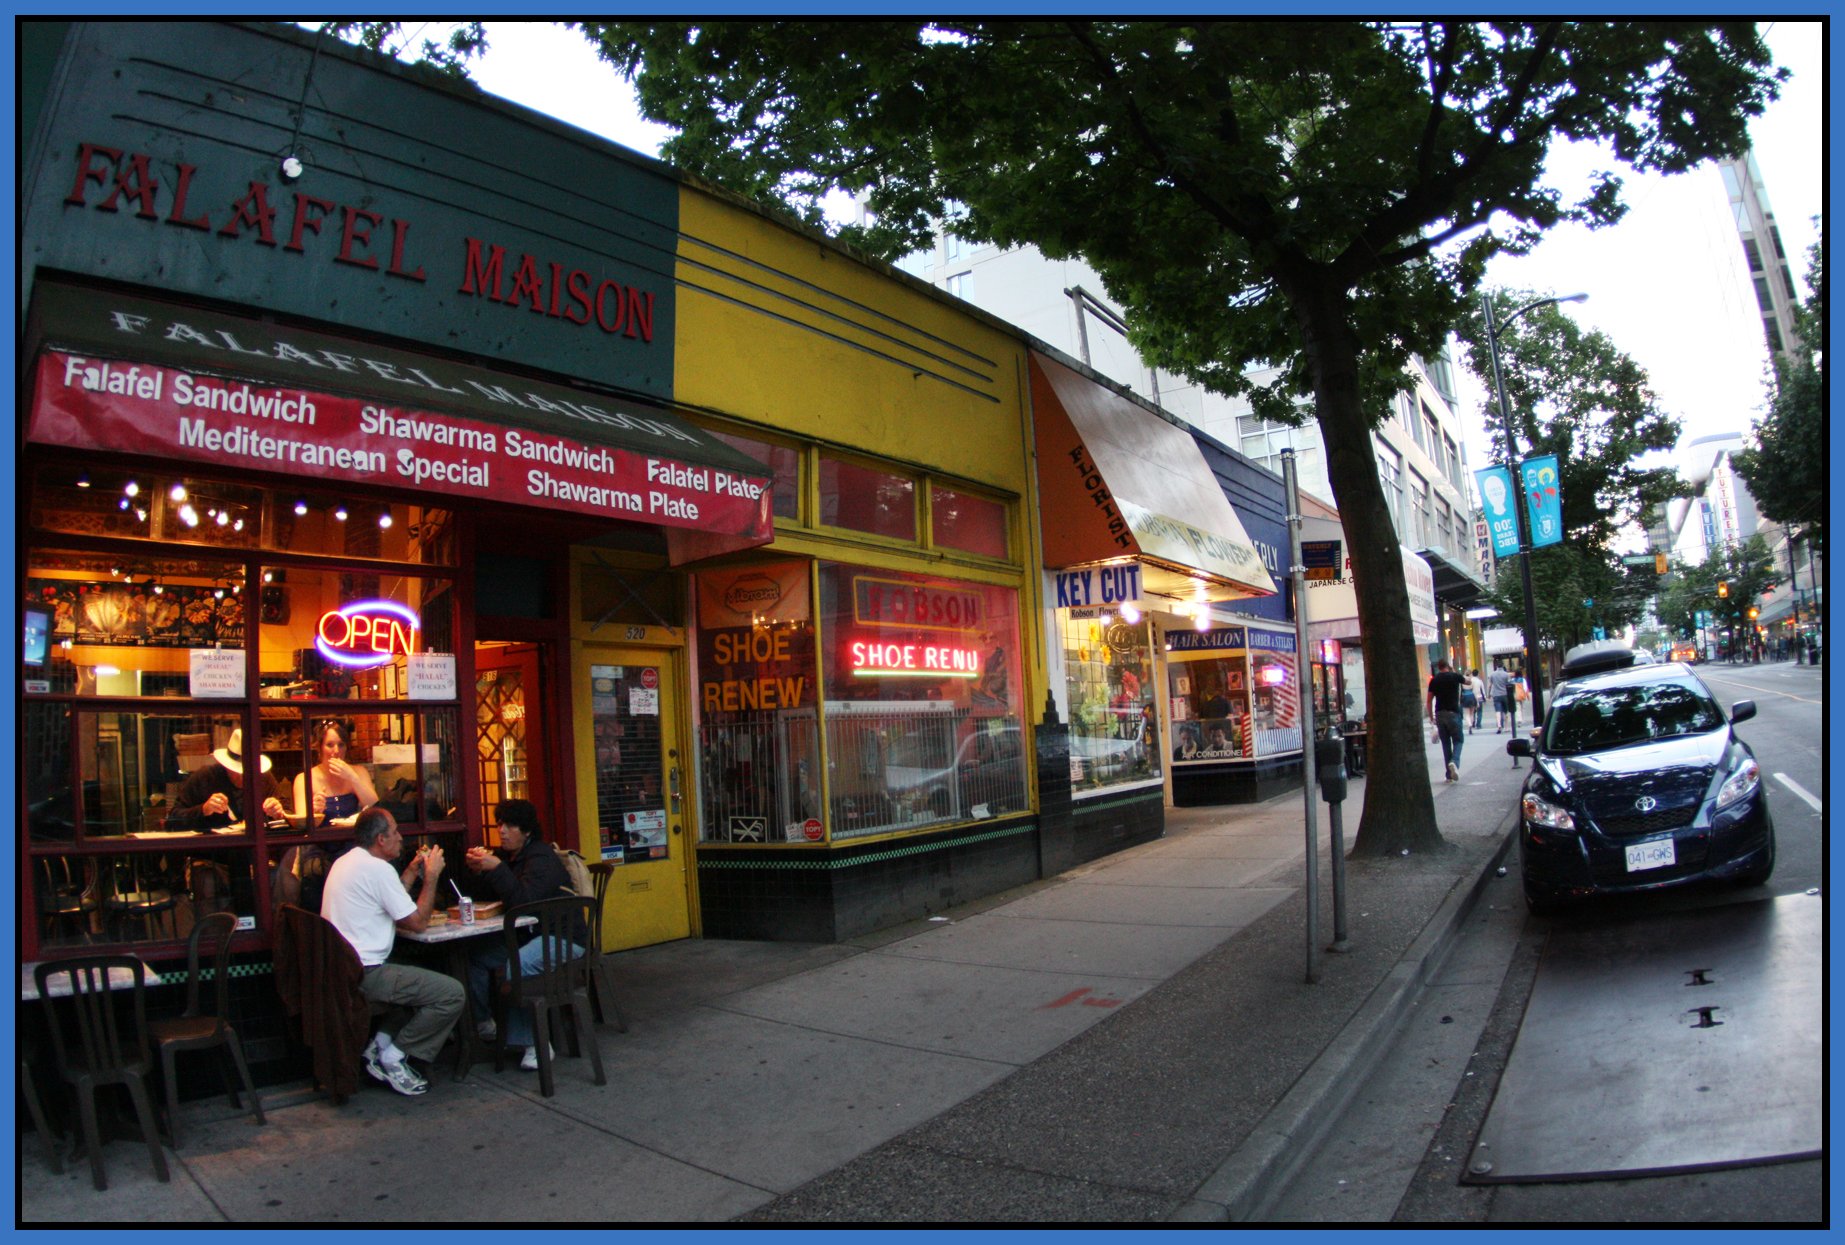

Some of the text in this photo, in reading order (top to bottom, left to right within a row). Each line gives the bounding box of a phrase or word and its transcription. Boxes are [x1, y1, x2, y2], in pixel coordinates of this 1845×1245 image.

[63, 143, 656, 343] FALAFEL MAISON
[63, 356, 316, 425] Falafel Sandwich
[110, 310, 704, 448] FALAFEL MAISON
[178, 417, 489, 488] Mediterranean Special
[360, 405, 615, 475] Shawarma Sandwich
[527, 469, 699, 520] Shawarma Plate
[647, 459, 760, 501] Falafel Plate
[1068, 445, 1131, 549] FLORIST
[1250, 539, 1279, 572] ERLY
[1057, 565, 1139, 608] KEY CUT
[1309, 577, 1347, 588] JAPANESE
[867, 585, 977, 626] ROBSON
[1071, 606, 1120, 618] Robson Flower
[318, 609, 418, 656] OPEN
[625, 626, 646, 641] 520
[714, 630, 791, 665] SHOE
[1169, 634, 1199, 649] HAIR
[1201, 631, 1242, 647] SALON
[1250, 632, 1271, 646] BARBER
[1275, 635, 1294, 649] STYLIST
[203, 672, 233, 680] CHICKEN
[852, 642, 978, 672] SHOE RENU
[703, 677, 804, 713] RENEW
[1182, 752, 1195, 760] AIR
